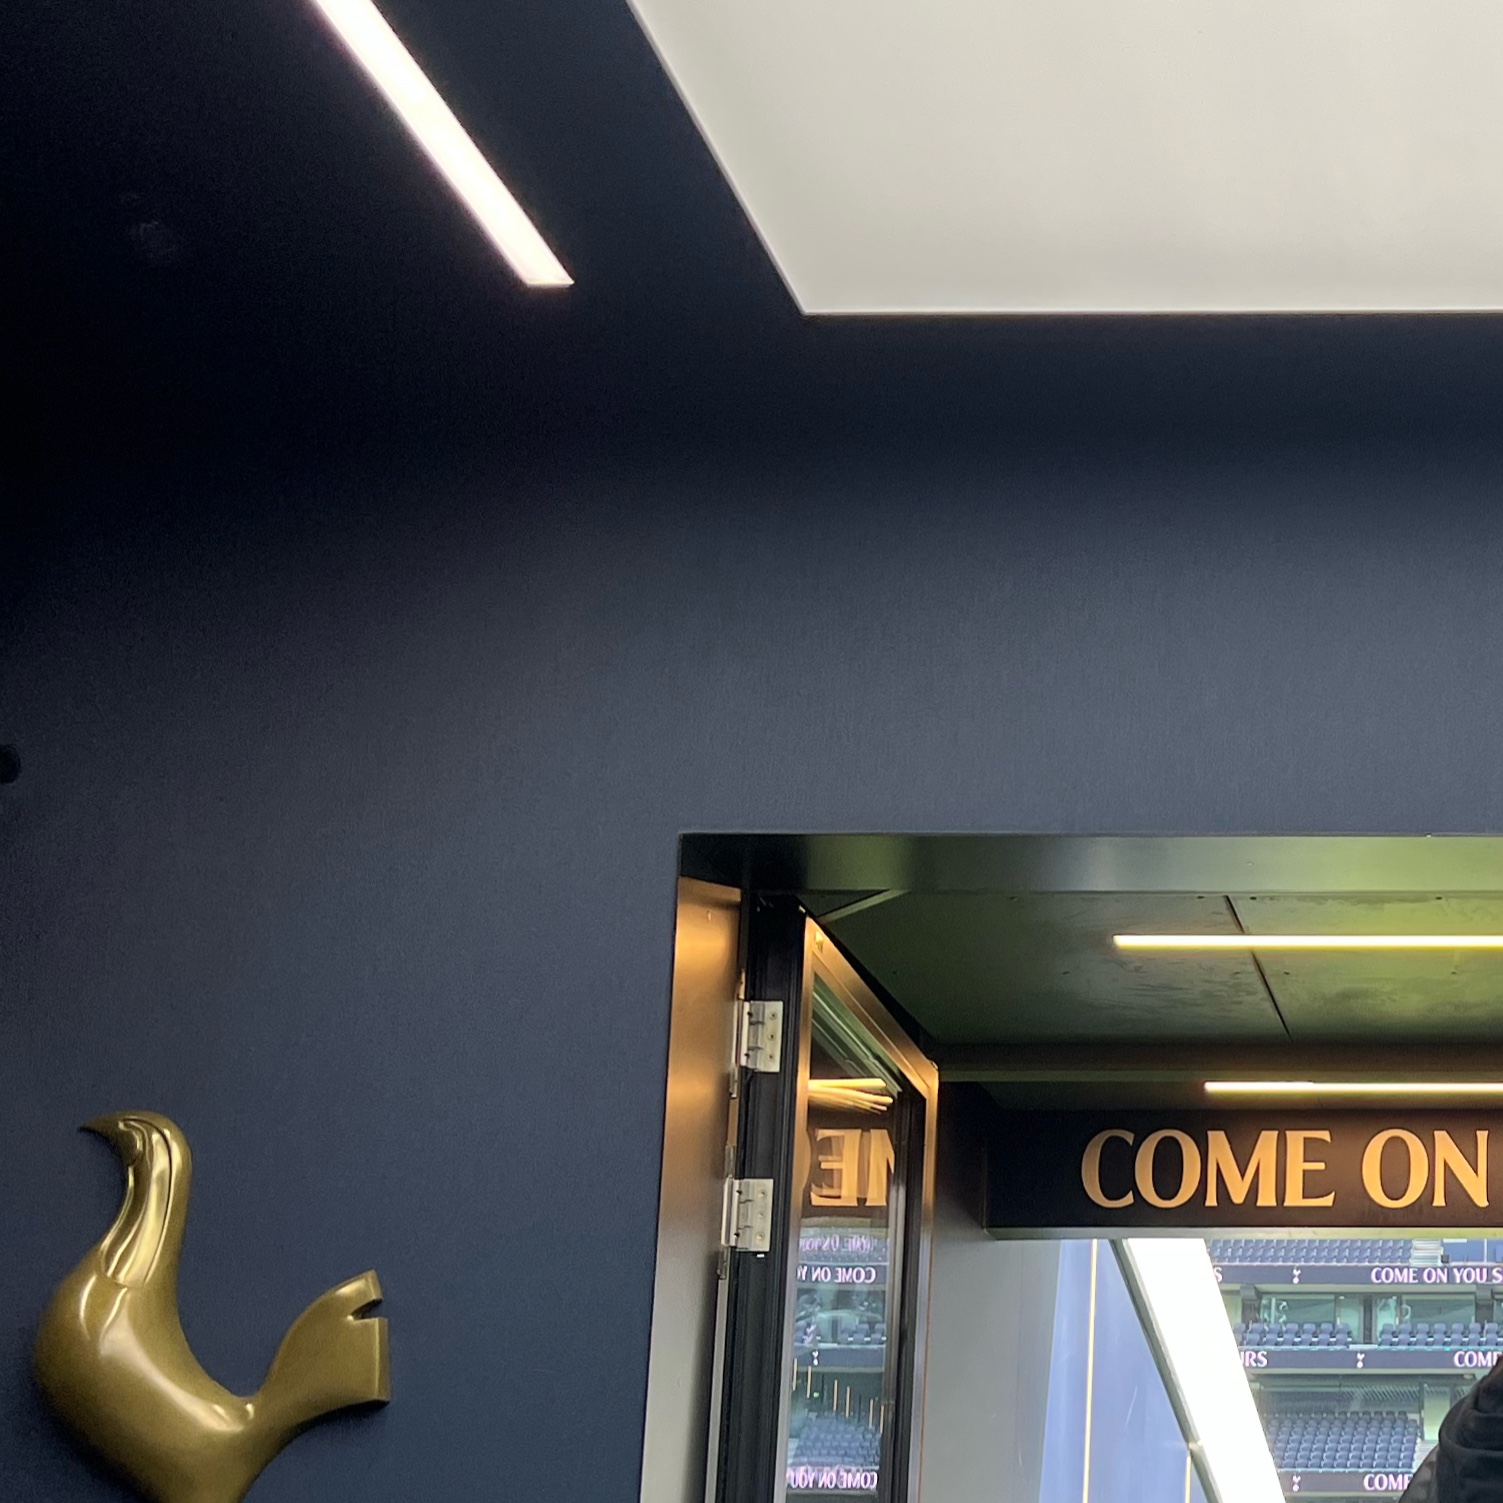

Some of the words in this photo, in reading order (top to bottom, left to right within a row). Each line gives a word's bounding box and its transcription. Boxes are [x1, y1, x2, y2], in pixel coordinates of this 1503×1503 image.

[1081, 1128, 1336, 1209] COME
[1361, 1128, 1490, 1209] ON
[1371, 1267, 1419, 1284] COME
[1422, 1267, 1448, 1284] ON
[1452, 1267, 1488, 1284] YOU
